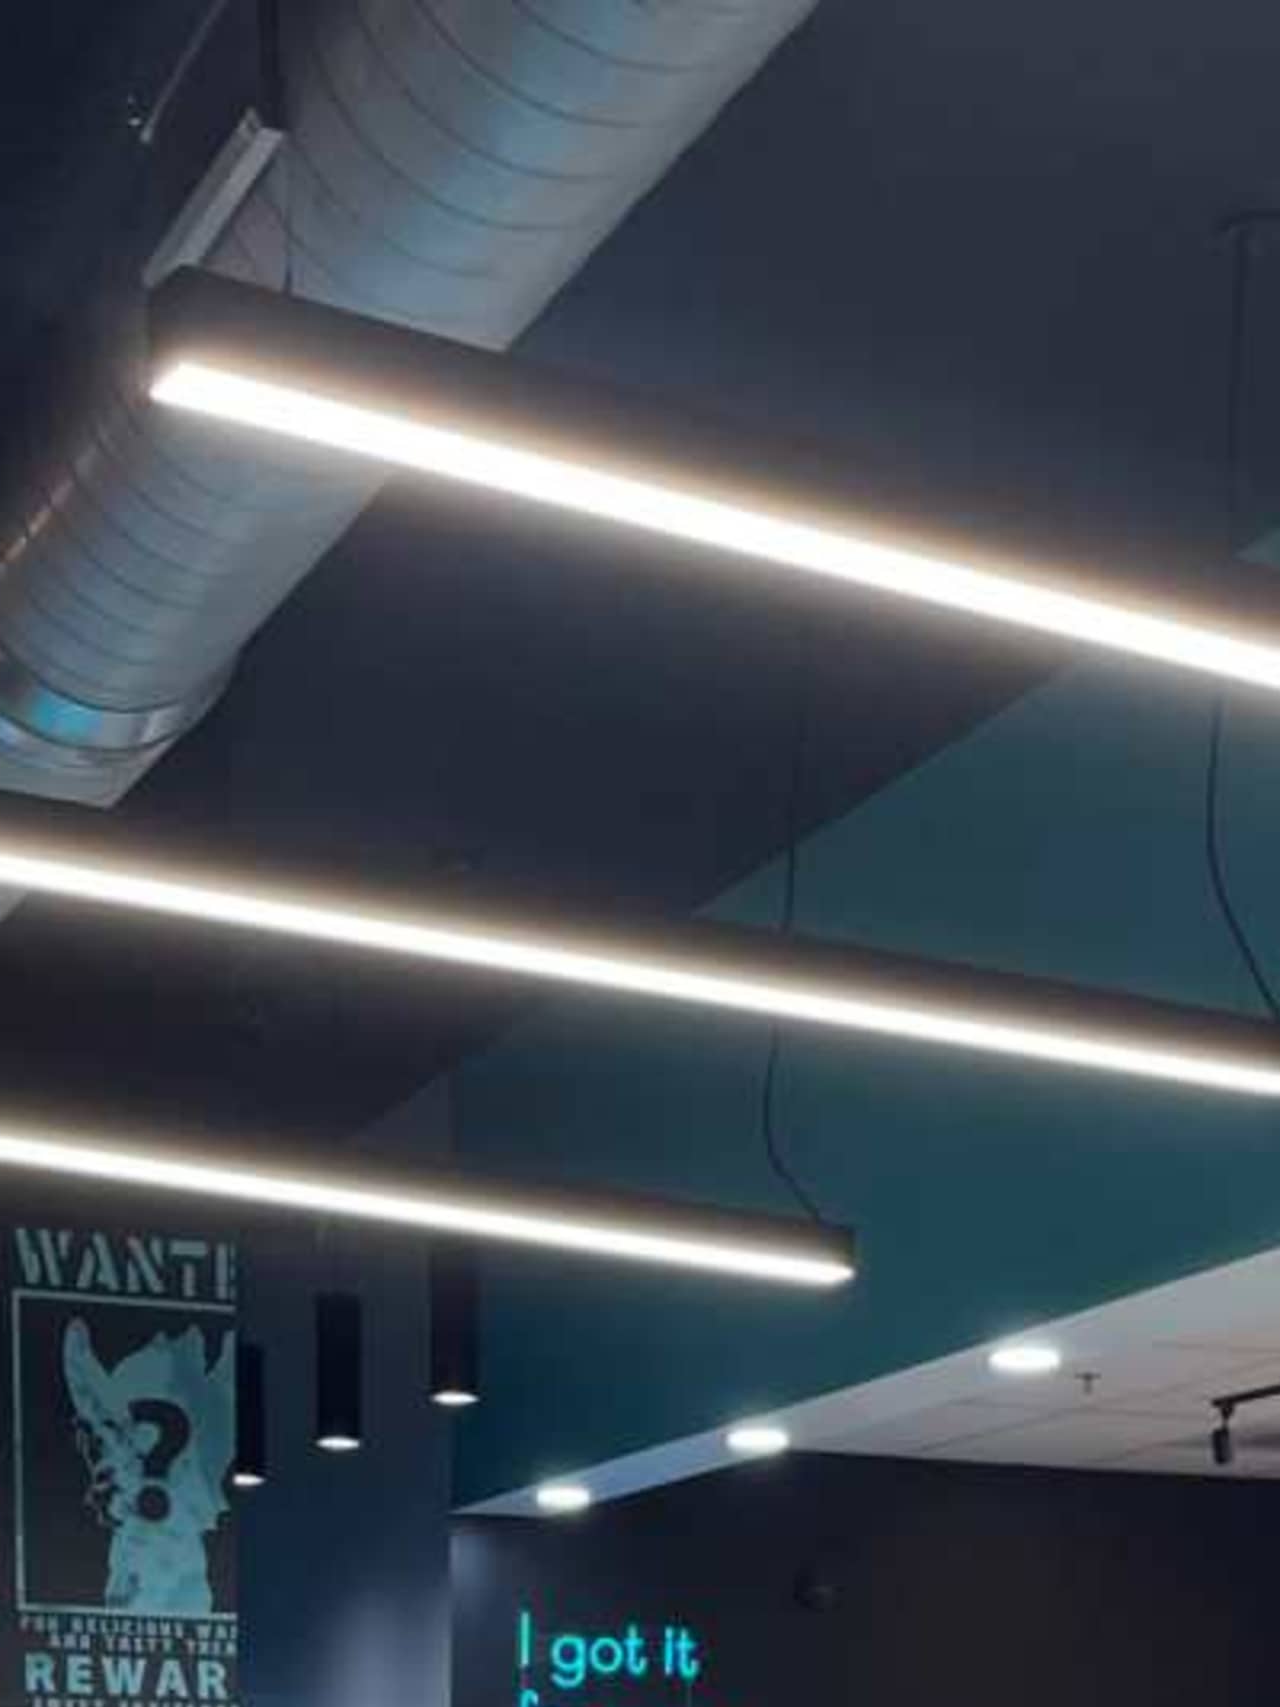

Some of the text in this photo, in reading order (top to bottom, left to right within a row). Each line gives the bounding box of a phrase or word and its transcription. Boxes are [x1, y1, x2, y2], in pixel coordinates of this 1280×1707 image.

[519, 1611, 700, 1688] I got it
